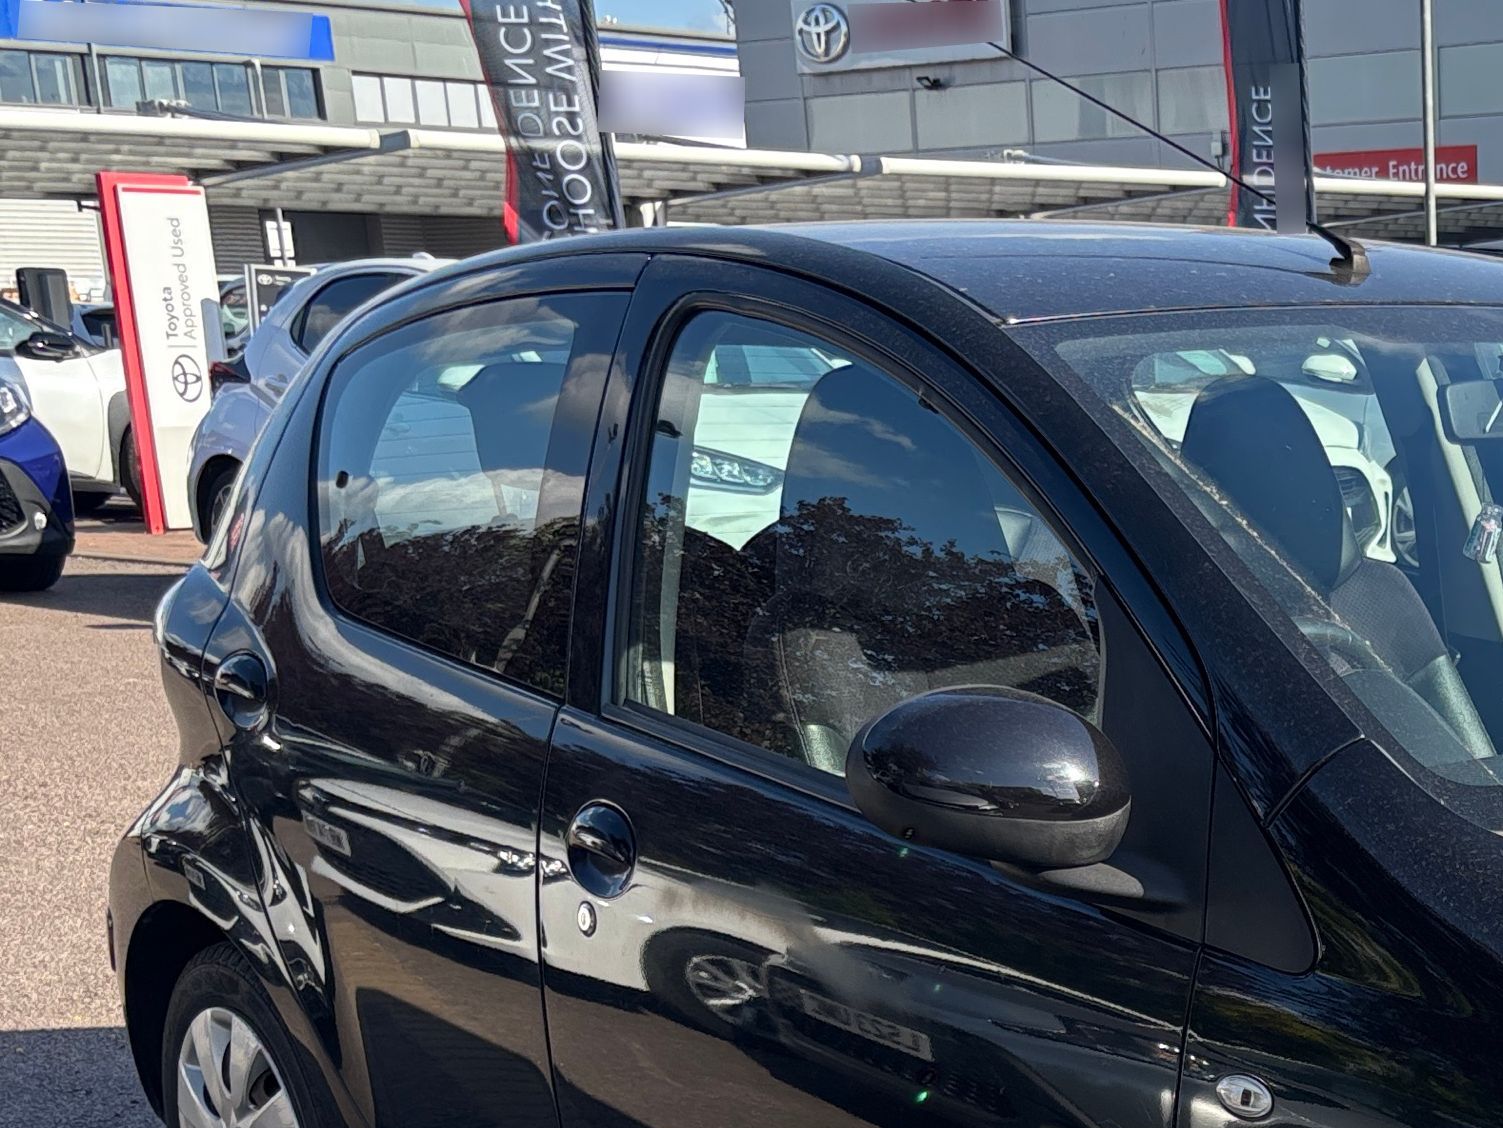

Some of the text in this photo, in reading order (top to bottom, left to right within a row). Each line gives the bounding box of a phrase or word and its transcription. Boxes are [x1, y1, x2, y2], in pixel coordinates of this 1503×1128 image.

[1388, 160, 1468, 181] Entrnce
[167, 217, 197, 340] Approved Used
[162, 286, 180, 340] Toyota
